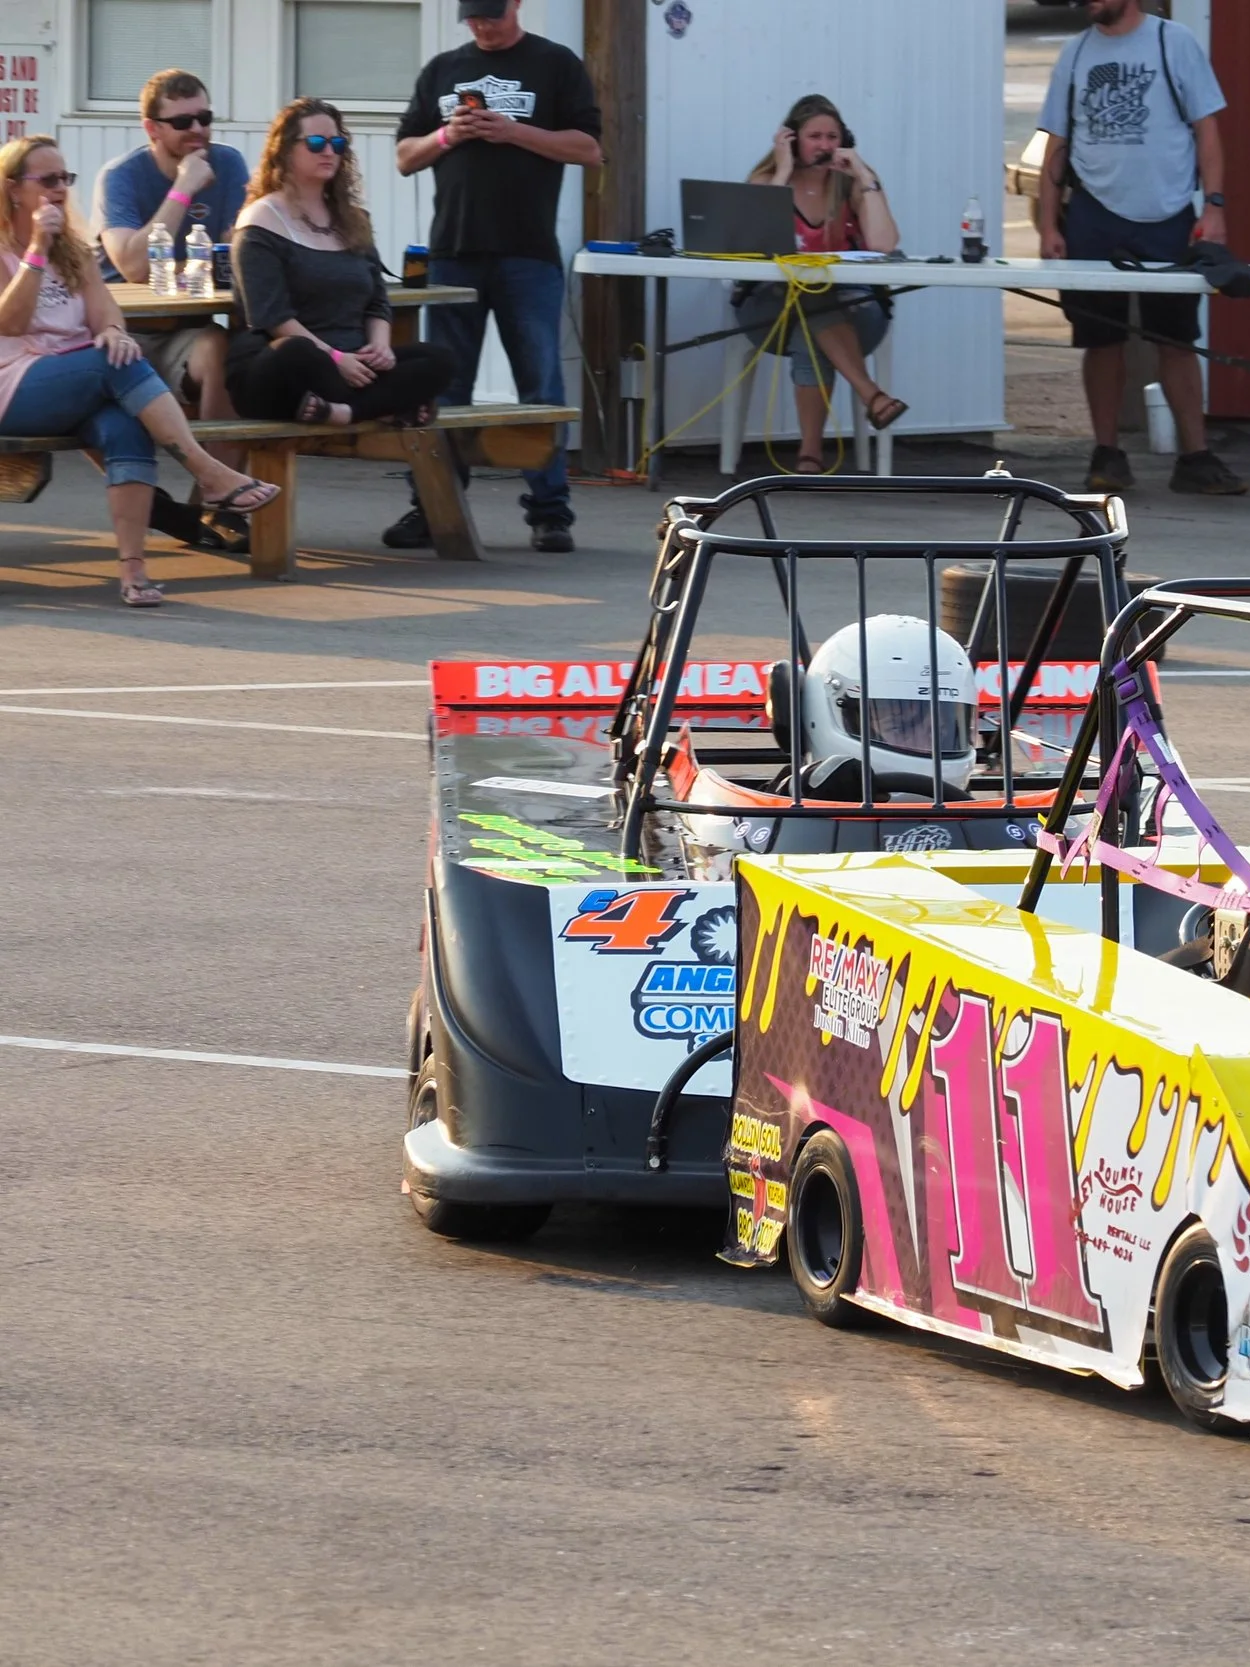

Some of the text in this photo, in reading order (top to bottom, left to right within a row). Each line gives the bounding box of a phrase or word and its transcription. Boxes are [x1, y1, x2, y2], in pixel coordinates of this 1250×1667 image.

[10, 55, 38, 81] AND
[23, 88, 39, 114] BE
[475, 665, 551, 698] BIG
[918, 686, 960, 698] zmp
[560, 888, 697, 955] 4
[645, 966, 736, 993] ANG
[811, 938, 881, 1001] RE/MAX
[643, 1005, 736, 1031] COM
[823, 986, 878, 1027] ELITE GROUP
[814, 1005, 871, 1049] Dustin Kline
[760, 1122, 782, 1162] SOUL
[930, 991, 1106, 1350] 11
[1099, 1158, 1143, 1186] BOUNCY
[1099, 1194, 1137, 1215] HOUSE
[738, 1208, 754, 1252] BBQ
[1107, 1224, 1152, 1251] RENTALS LLC
